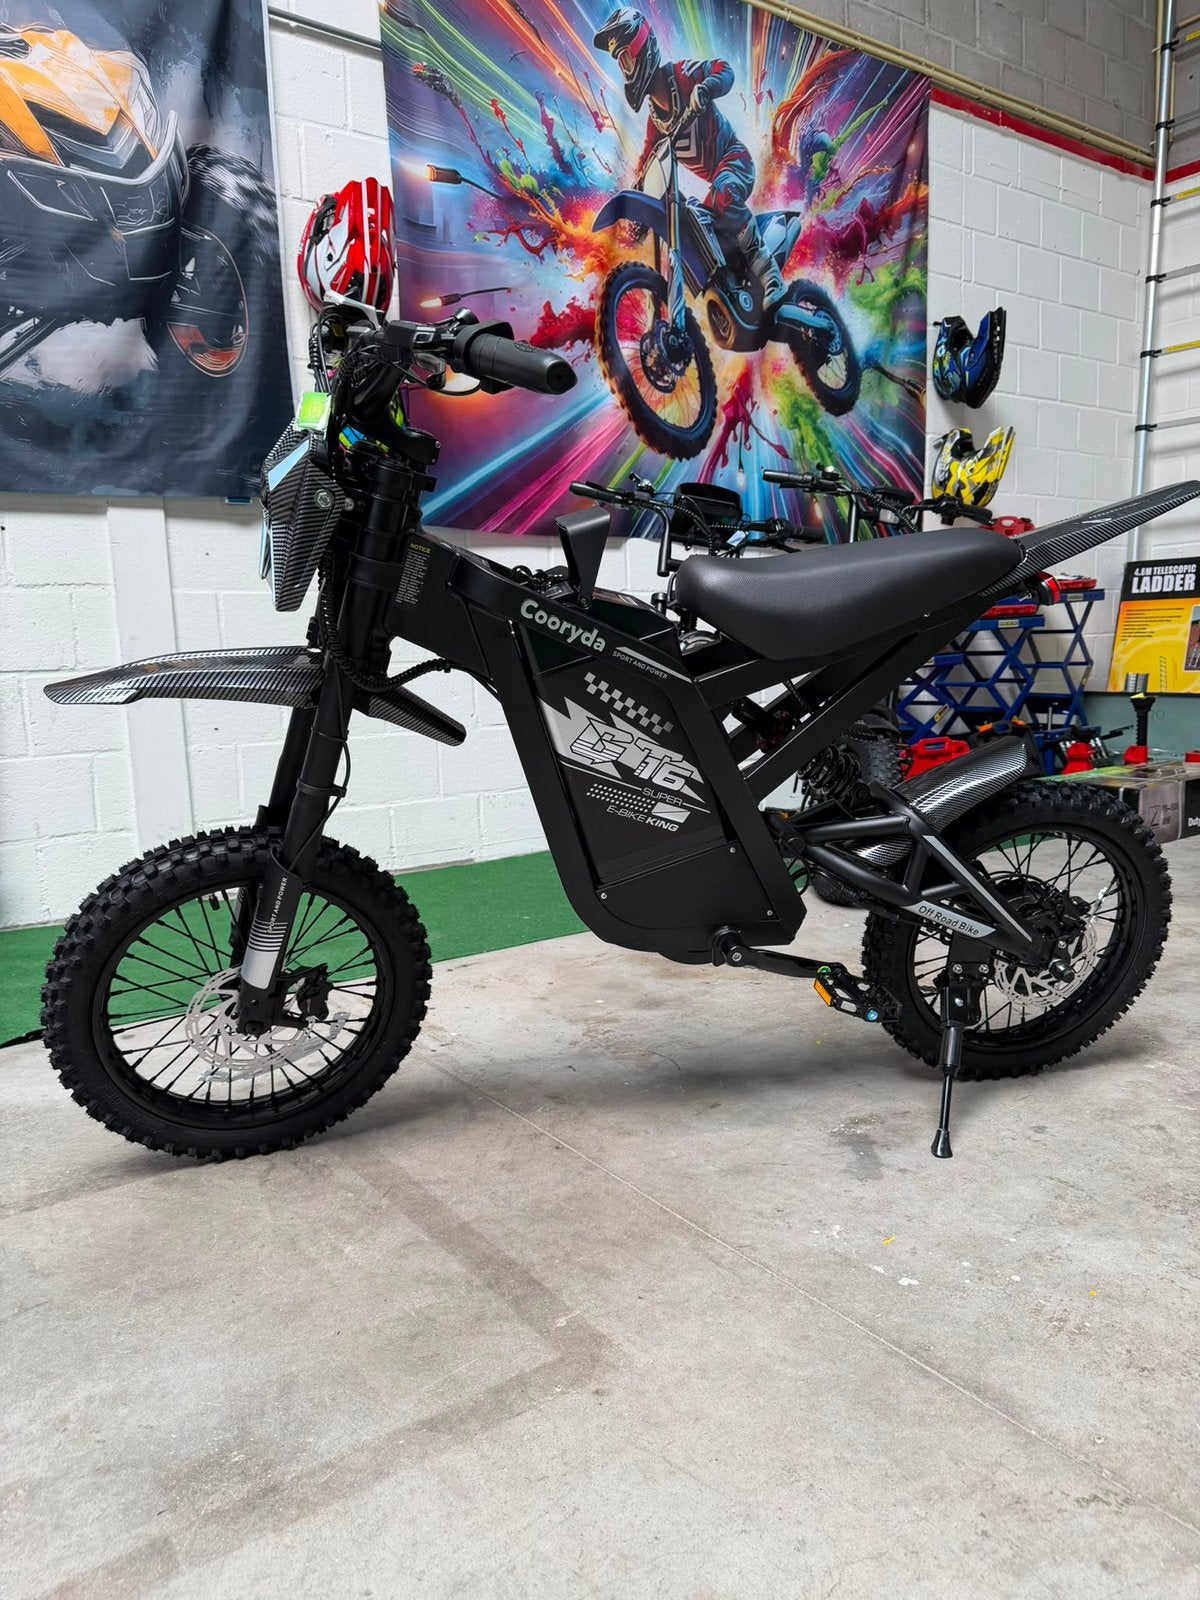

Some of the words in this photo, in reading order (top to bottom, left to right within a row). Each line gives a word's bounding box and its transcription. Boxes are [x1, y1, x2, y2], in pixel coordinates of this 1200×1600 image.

[1153, 564, 1197, 575] TELESCOPIC
[1131, 573, 1196, 594] LADDER
[520, 599, 606, 652] Cooryda
[612, 650, 634, 667] SPORT
[633, 660, 646, 670] AND
[646, 666, 668, 680] POWER
[642, 787, 683, 806] SUPER
[606, 805, 647, 822] E-BIKE
[645, 816, 679, 832] KING
[277, 877, 288, 900] POWER
[919, 905, 934, 916] Off
[934, 912, 958, 926] Road
[959, 922, 979, 935] Bike
